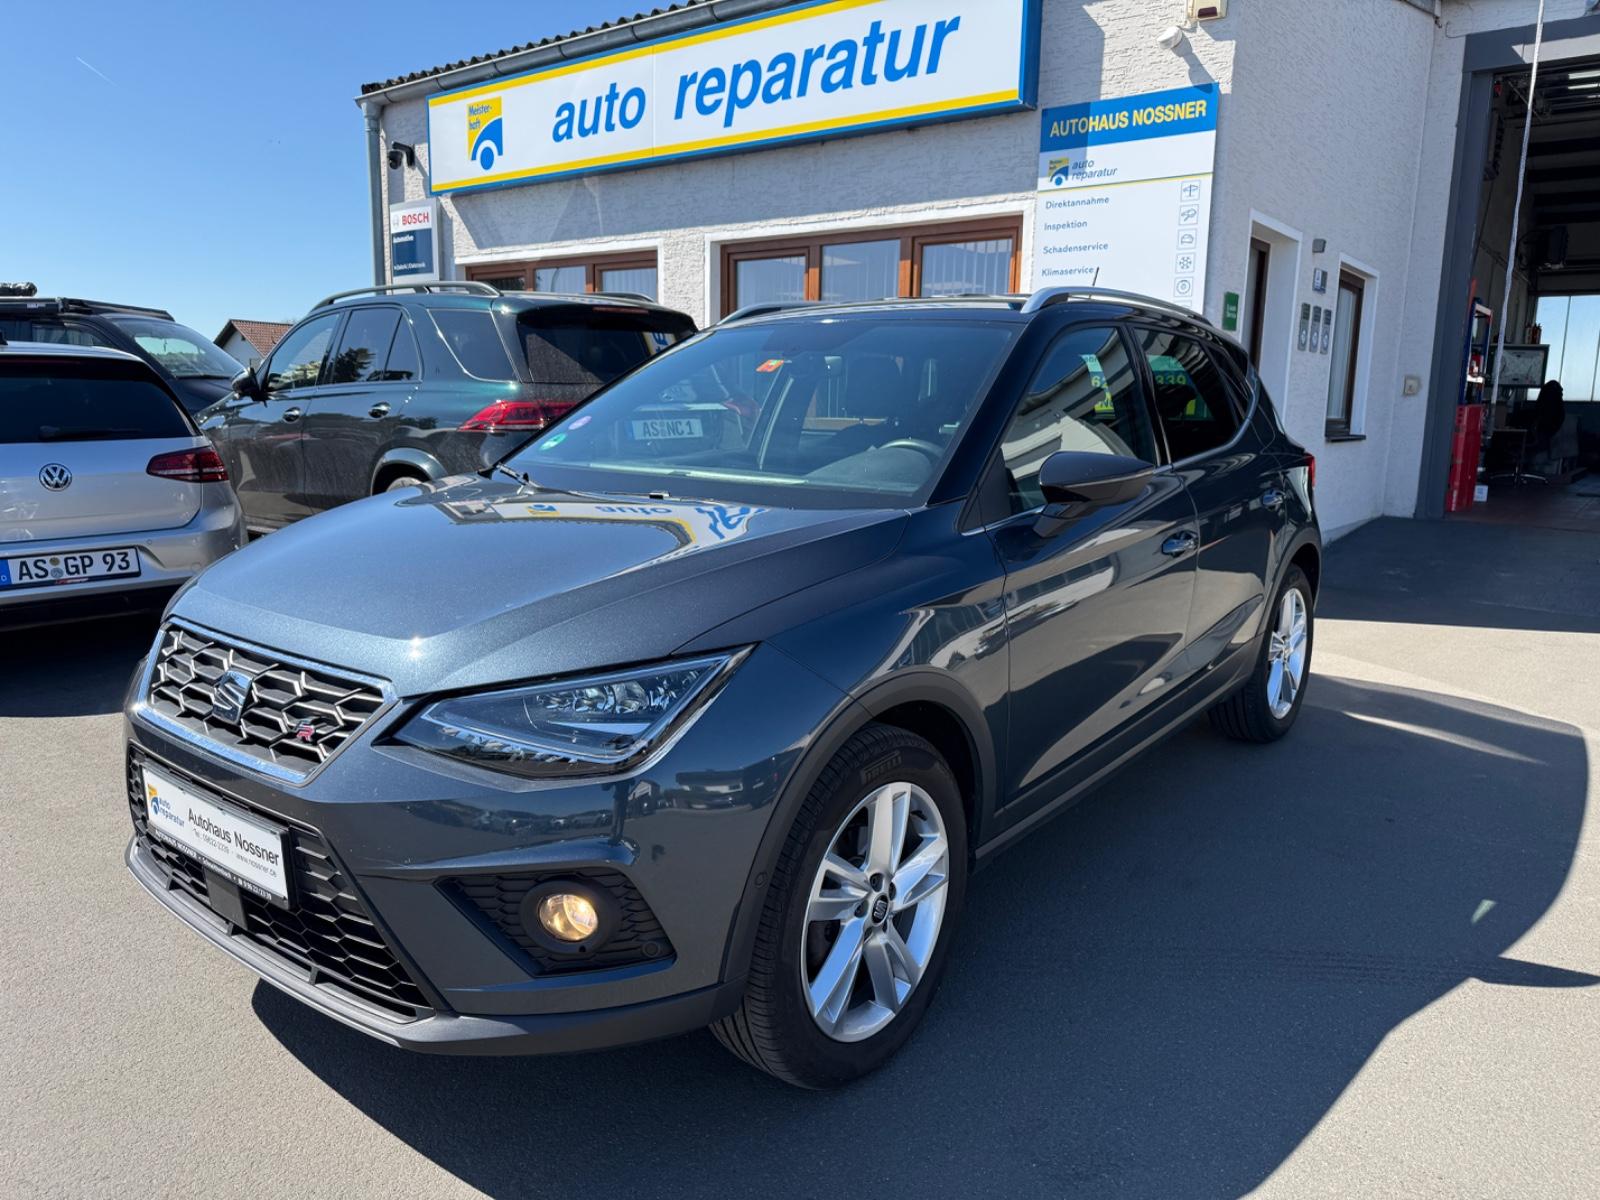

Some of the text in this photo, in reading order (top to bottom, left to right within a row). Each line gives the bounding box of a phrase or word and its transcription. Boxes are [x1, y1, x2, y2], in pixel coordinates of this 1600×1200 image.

[552, 15, 960, 143] auto reparatur
[1050, 99, 1207, 137] AUTOHAUS NOSSNER
[1071, 159, 1095, 170] auto
[1071, 167, 1118, 182] reparatur
[1045, 195, 1110, 210] Direktannahme
[401, 212, 430, 226] BOSCH
[1044, 219, 1088, 232] Inspektion
[1042, 241, 1109, 255] Schadenservice
[1041, 265, 1094, 277] Klimaservice
[643, 420, 695, 438] AS NC 1
[18, 558, 49, 581] AS
[64, 554, 94, 577] GP
[102, 551, 130, 573] 93
[188, 807, 232, 844] Autohaus
[234, 831, 279, 866] Nossner
